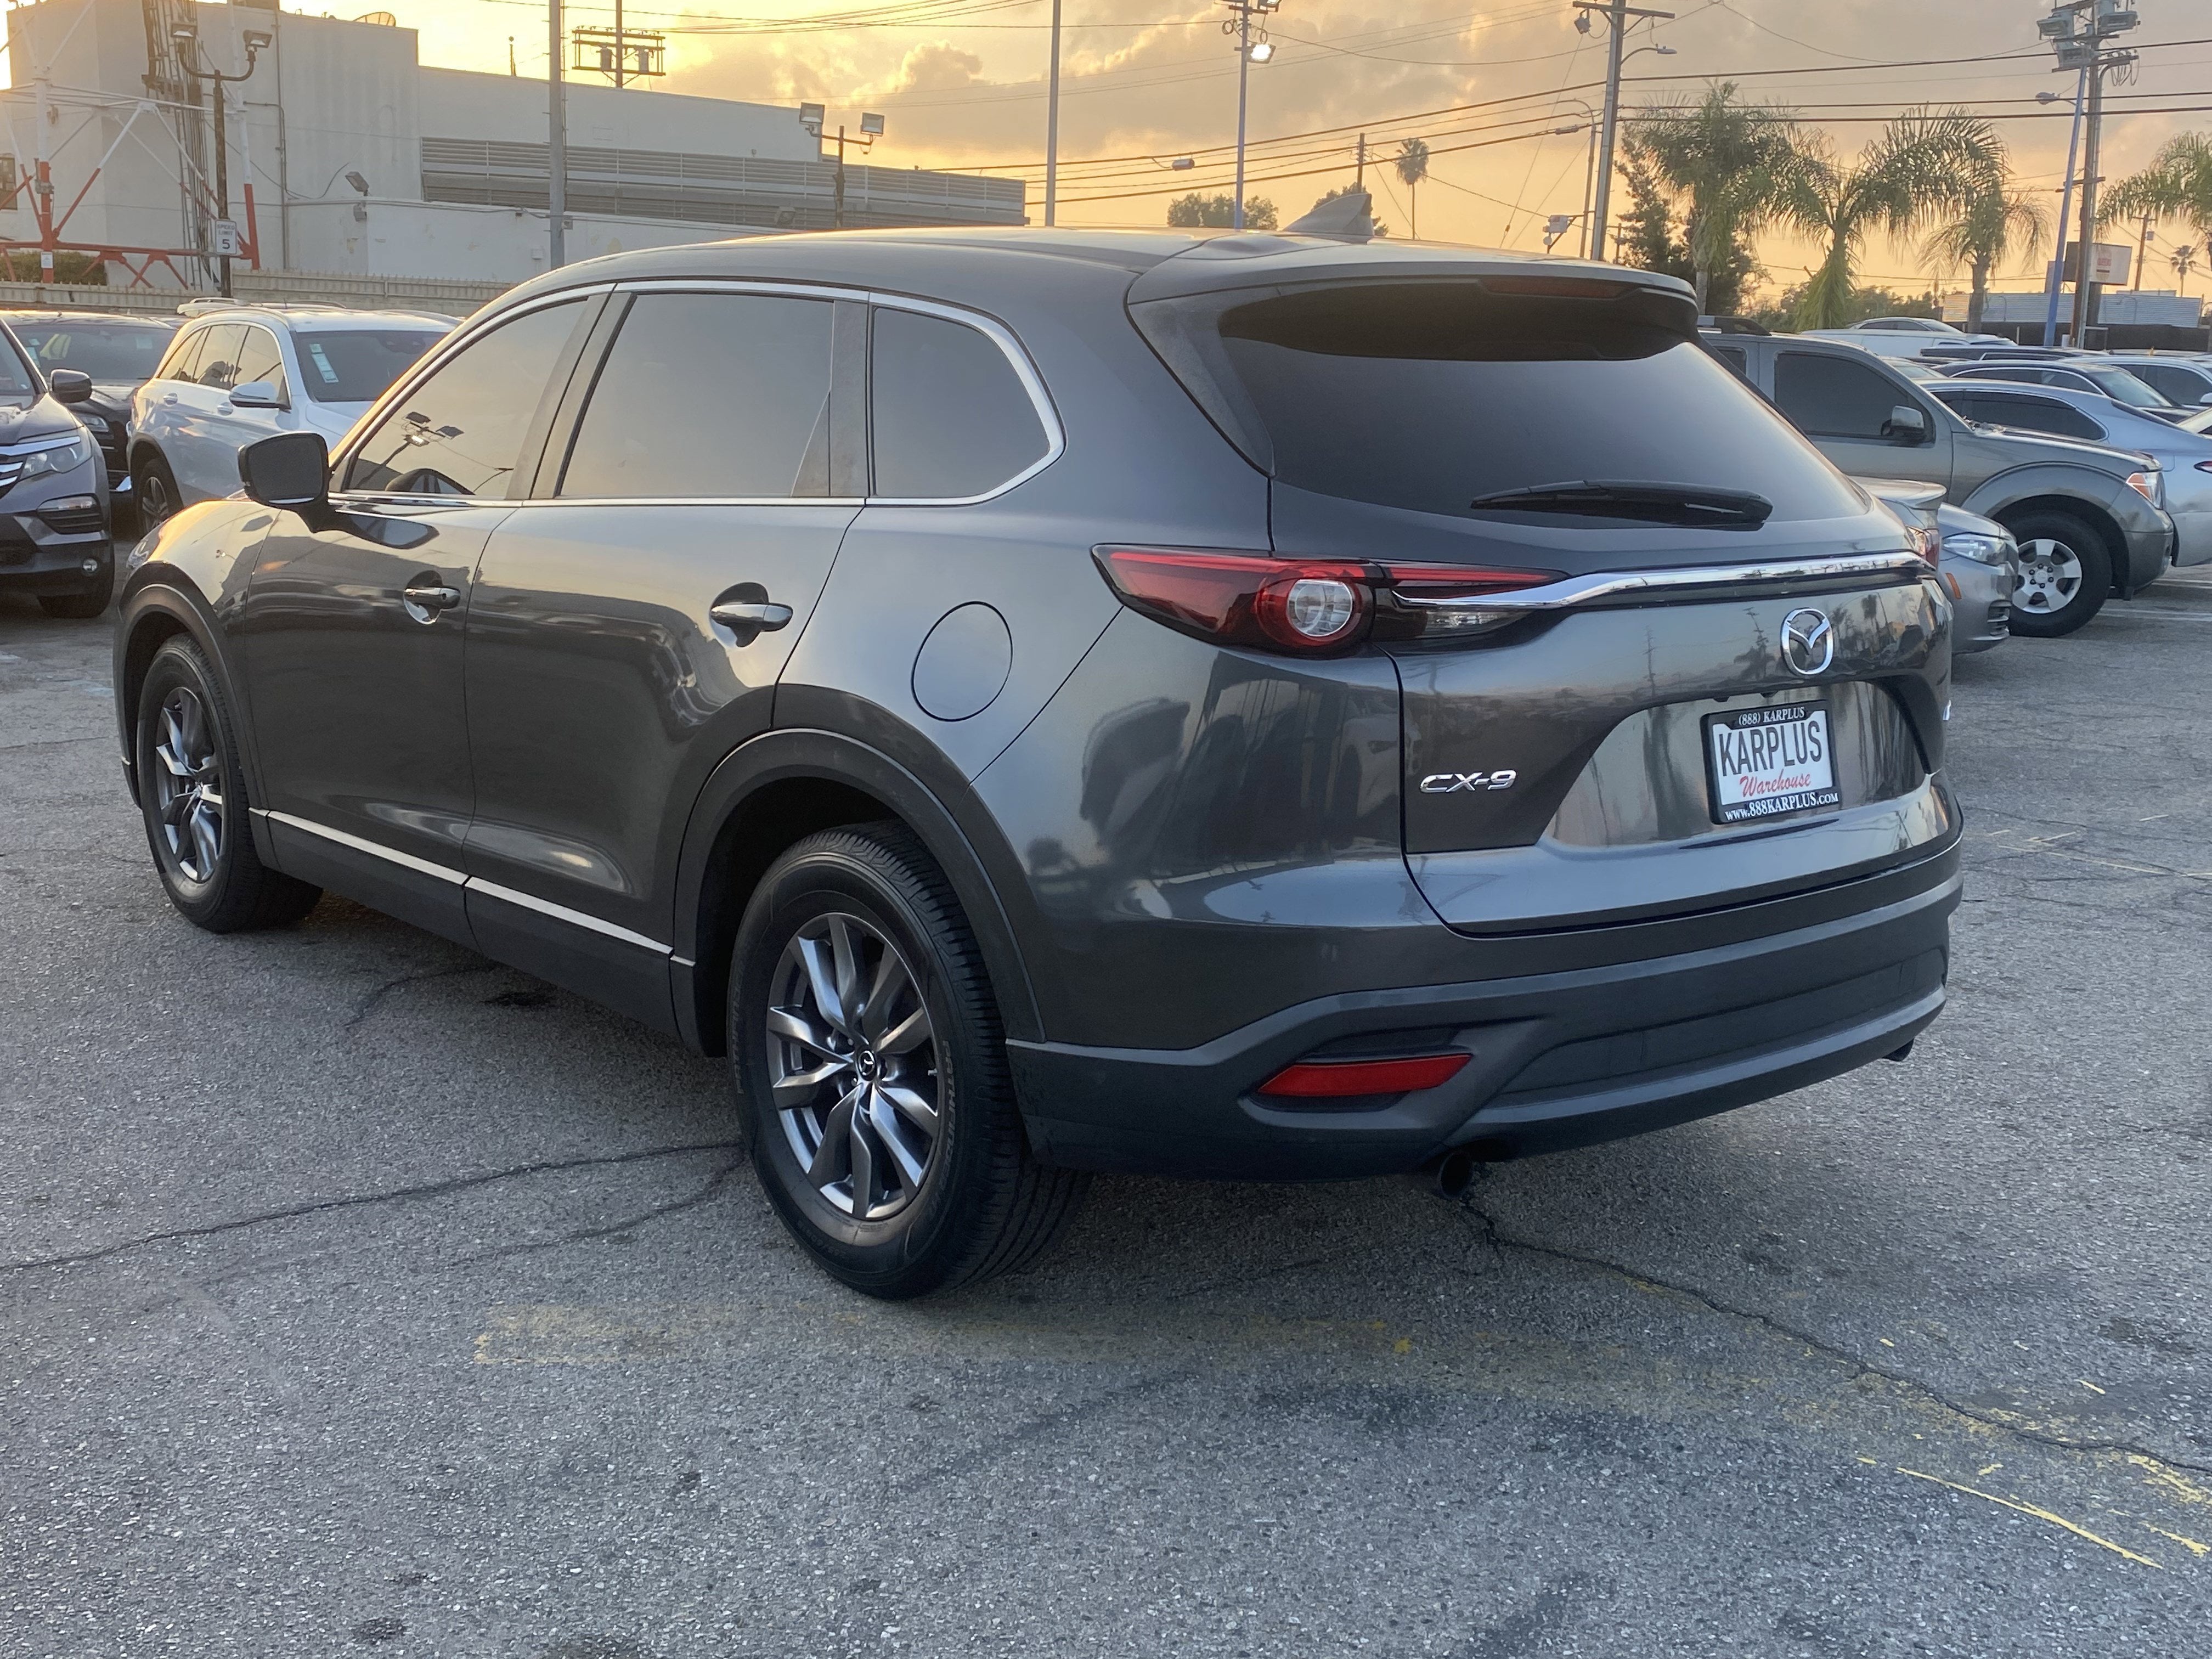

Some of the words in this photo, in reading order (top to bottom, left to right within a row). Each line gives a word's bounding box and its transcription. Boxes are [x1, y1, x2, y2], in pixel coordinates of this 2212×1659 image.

[222, 238, 230, 249] 5
[1738, 712, 1760, 726] (888)
[1763, 707, 1804, 723] KARPLUS
[1719, 720, 1822, 777] KARPLUS
[1420, 770, 1517, 793] CX-9
[1739, 769, 1810, 798] Warehouse
[939, 1040, 956, 1190] PATHFINDER
